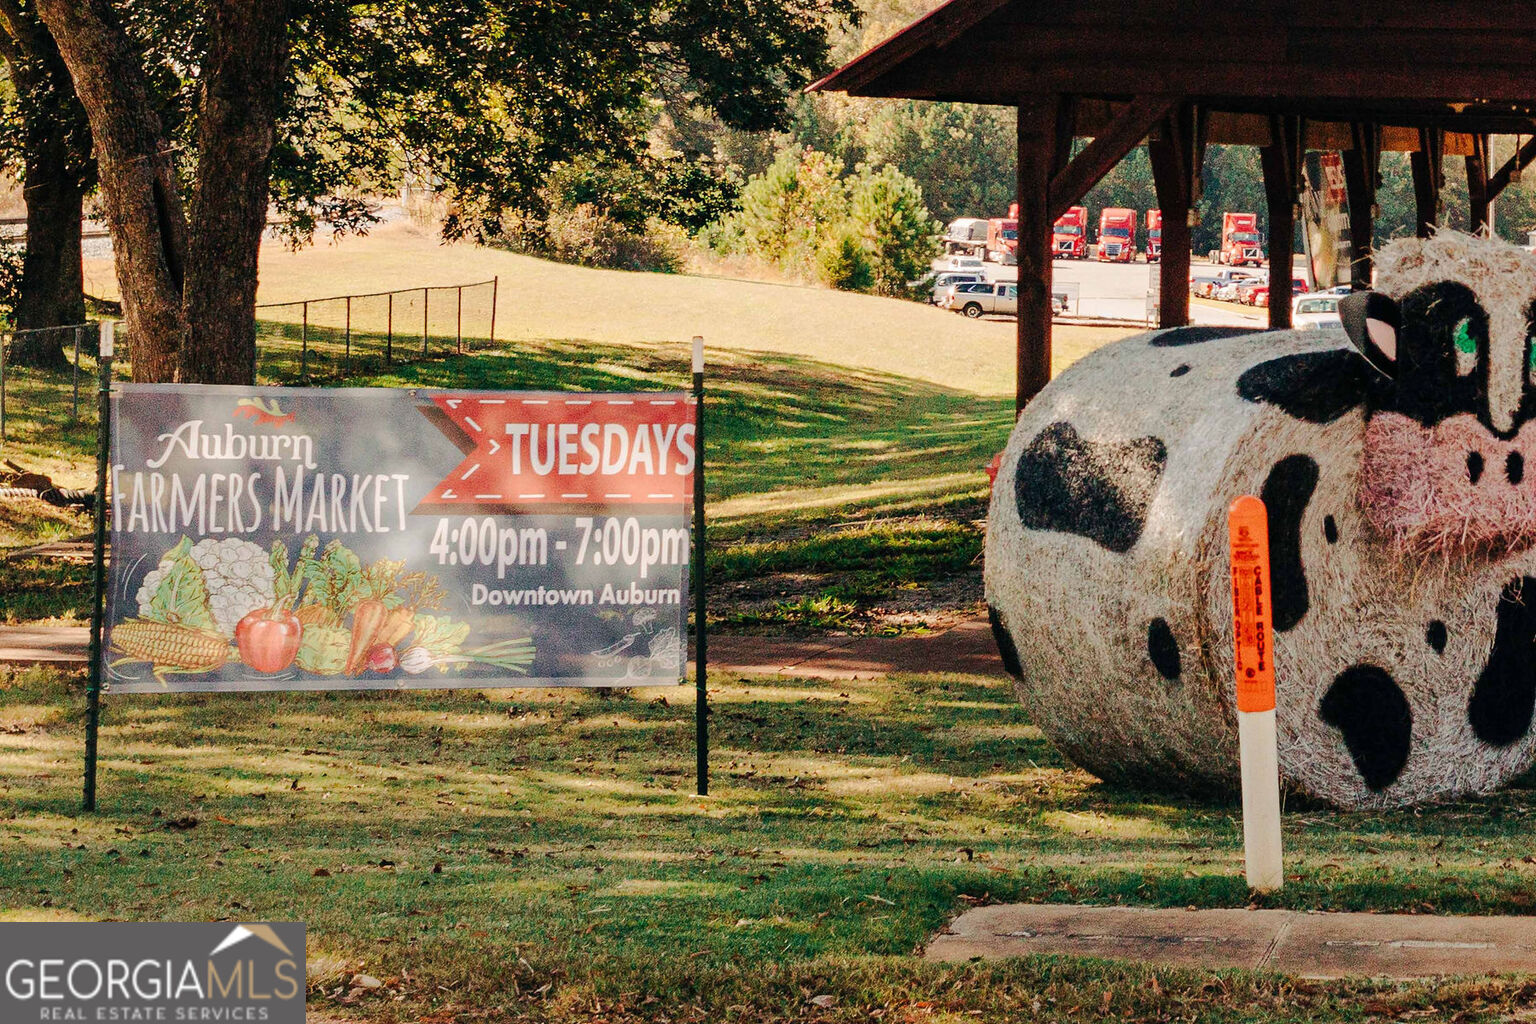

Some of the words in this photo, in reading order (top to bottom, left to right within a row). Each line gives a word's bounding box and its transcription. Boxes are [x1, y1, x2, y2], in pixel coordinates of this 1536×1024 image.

[146, 420, 317, 469] Auburn
[505, 423, 696, 475] TUESDAYS
[112, 464, 262, 536] FARMERS
[273, 464, 409, 534] MARKET
[429, 517, 547, 579] 4:00pm
[555, 540, 567, 550] -
[575, 517, 689, 578] 7:00pm
[471, 583, 594, 606] Downtown
[599, 582, 681, 605] Auburn
[1253, 565, 1263, 616] CABLE
[1256, 622, 1266, 671] ROUTE
